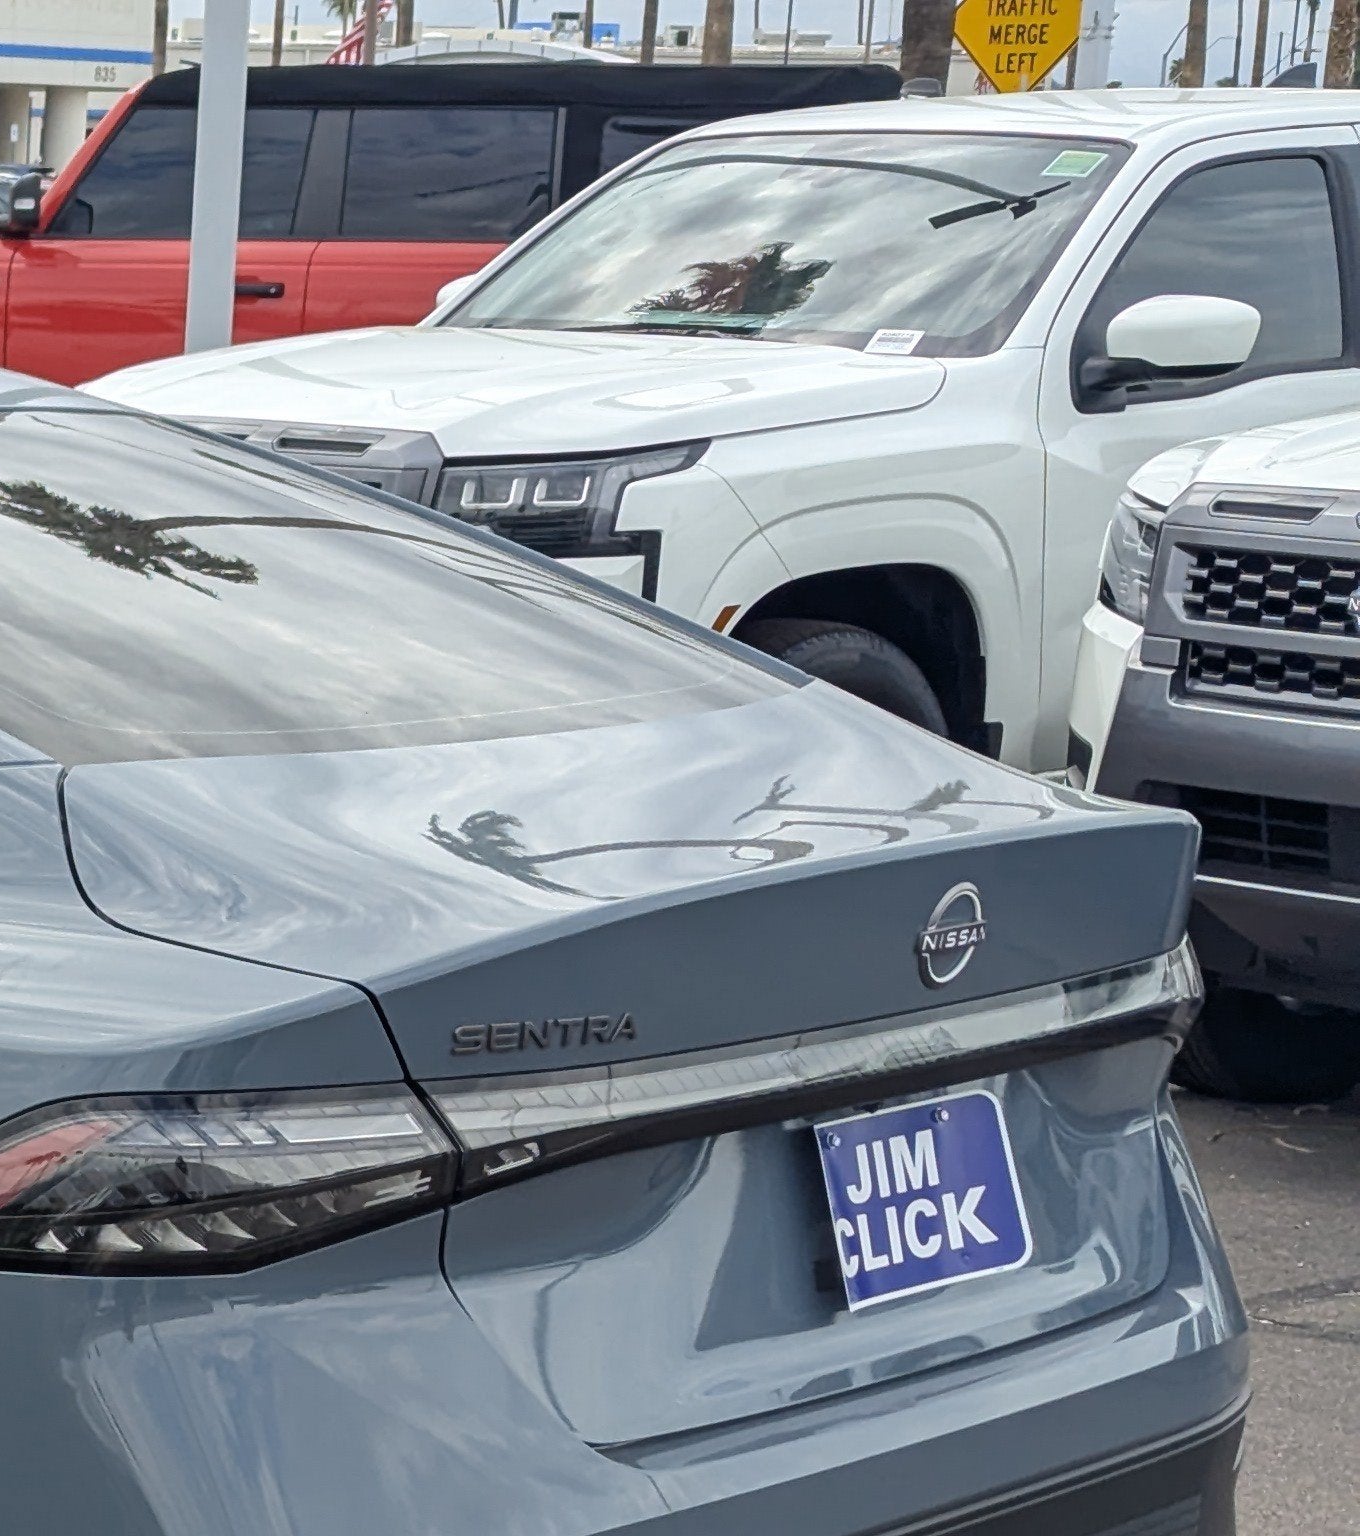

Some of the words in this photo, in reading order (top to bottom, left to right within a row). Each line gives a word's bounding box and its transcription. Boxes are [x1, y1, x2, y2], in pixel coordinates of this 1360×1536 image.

[987, 0, 1058, 16] TRAFFIC
[988, 23, 1050, 45] MERGE
[995, 52, 1037, 74] LEFT
[921, 926, 986, 951] NISSAN
[451, 1008, 636, 1056] SENTRA
[846, 1129, 940, 1205] JIM
[835, 1186, 999, 1278] CLICK
